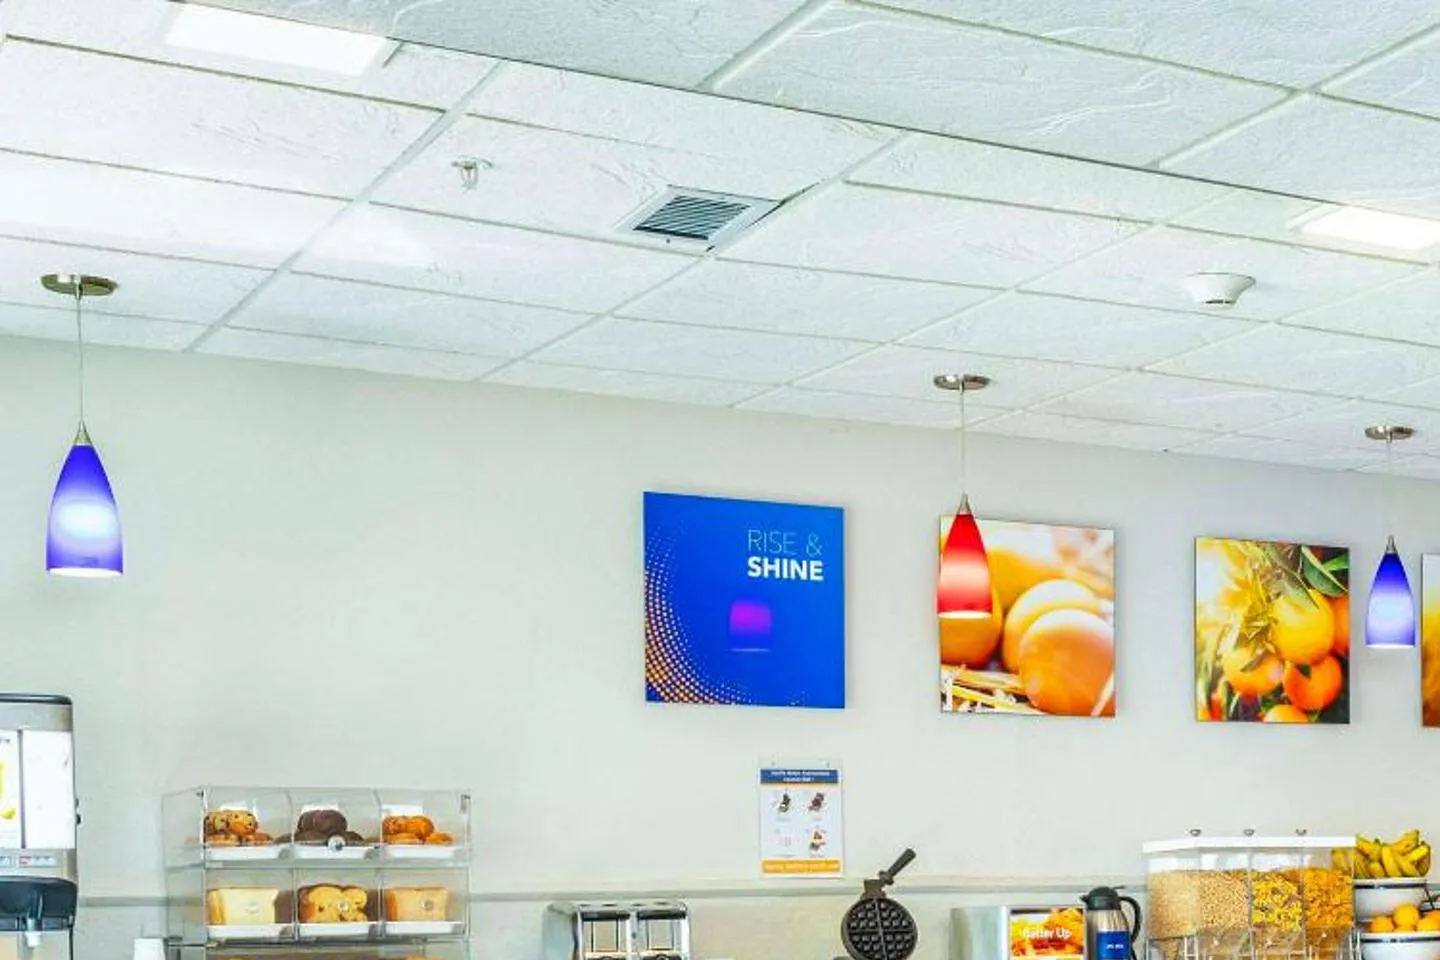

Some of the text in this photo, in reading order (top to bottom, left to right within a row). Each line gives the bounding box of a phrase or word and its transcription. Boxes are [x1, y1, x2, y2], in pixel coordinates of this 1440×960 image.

[747, 529, 822, 557] RISE &
[747, 555, 824, 581] SHINE
[1055, 926, 1072, 940] Up
